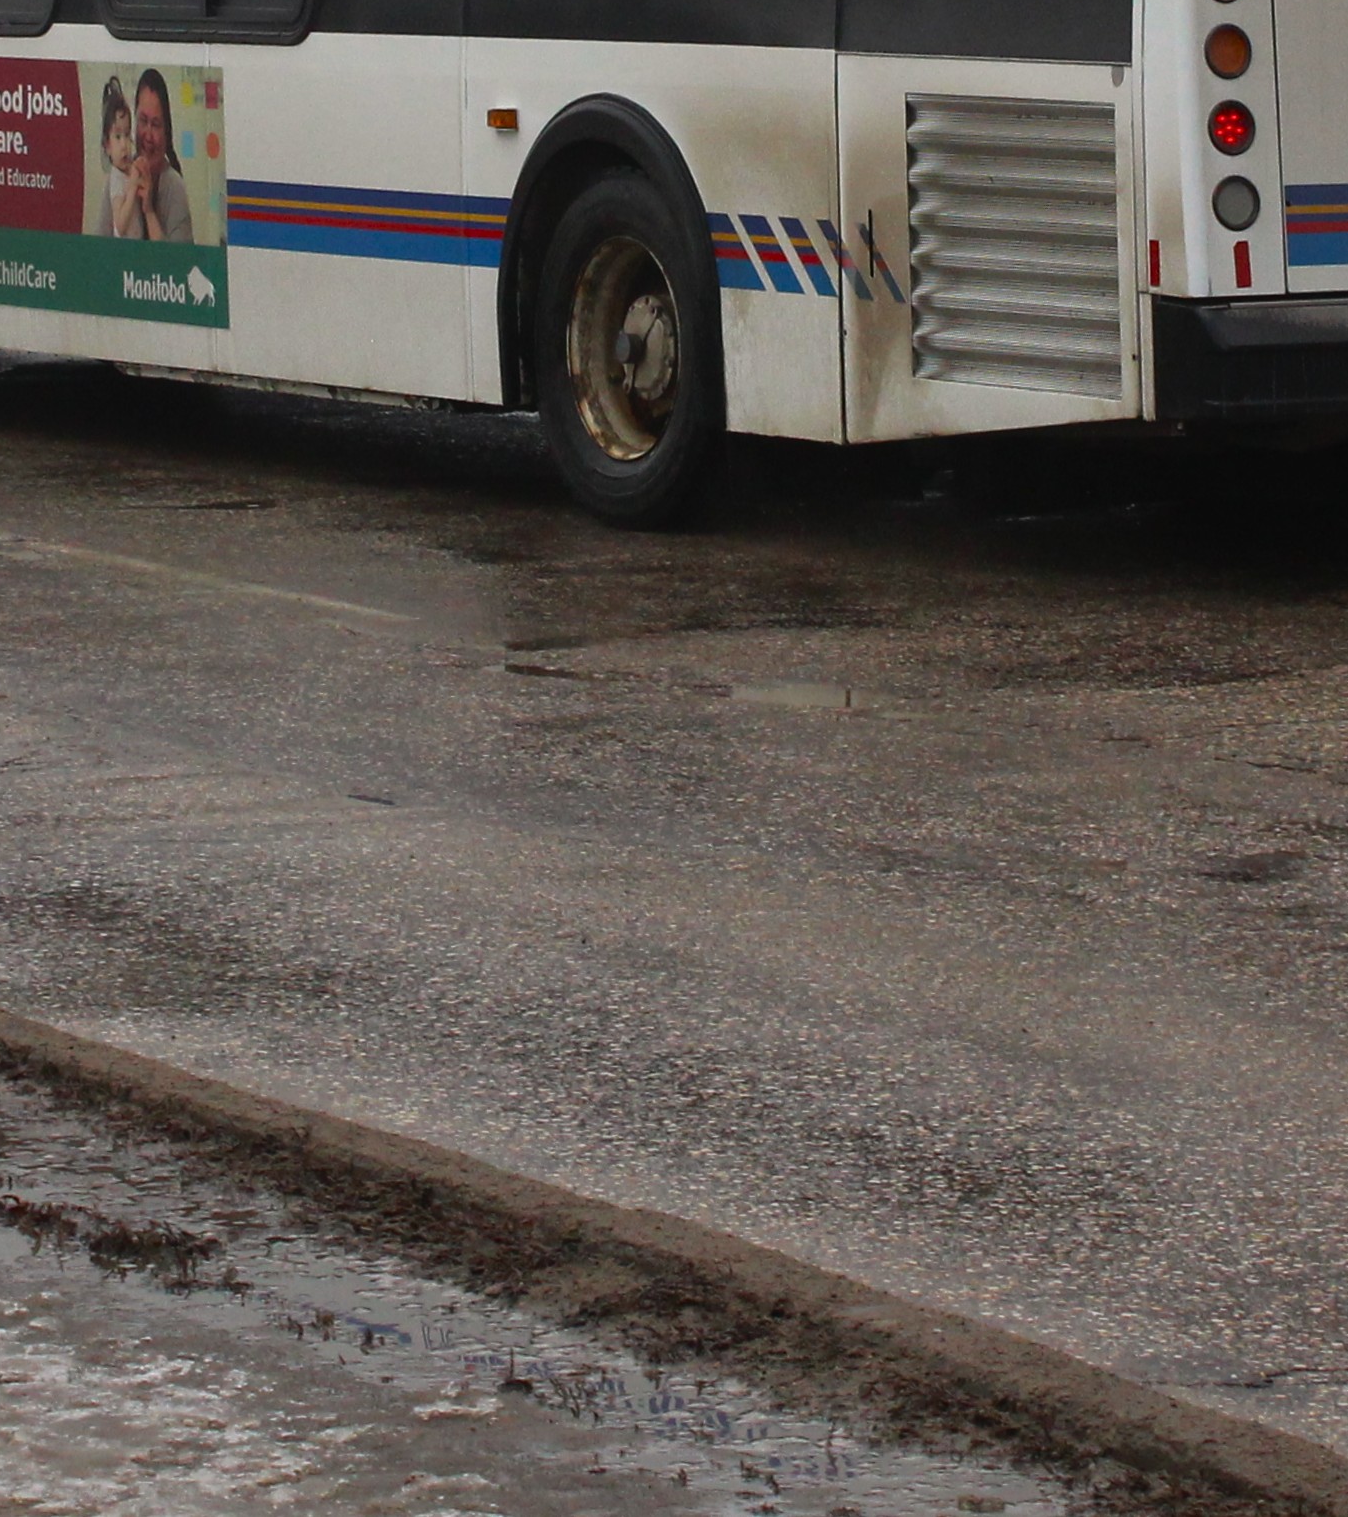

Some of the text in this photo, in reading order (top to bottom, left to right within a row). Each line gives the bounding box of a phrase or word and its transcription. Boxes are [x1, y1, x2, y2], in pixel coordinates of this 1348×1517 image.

[26, 84, 68, 120] jobs.
[7, 168, 54, 189] Educator.
[123, 271, 185, 304] Manitoba
